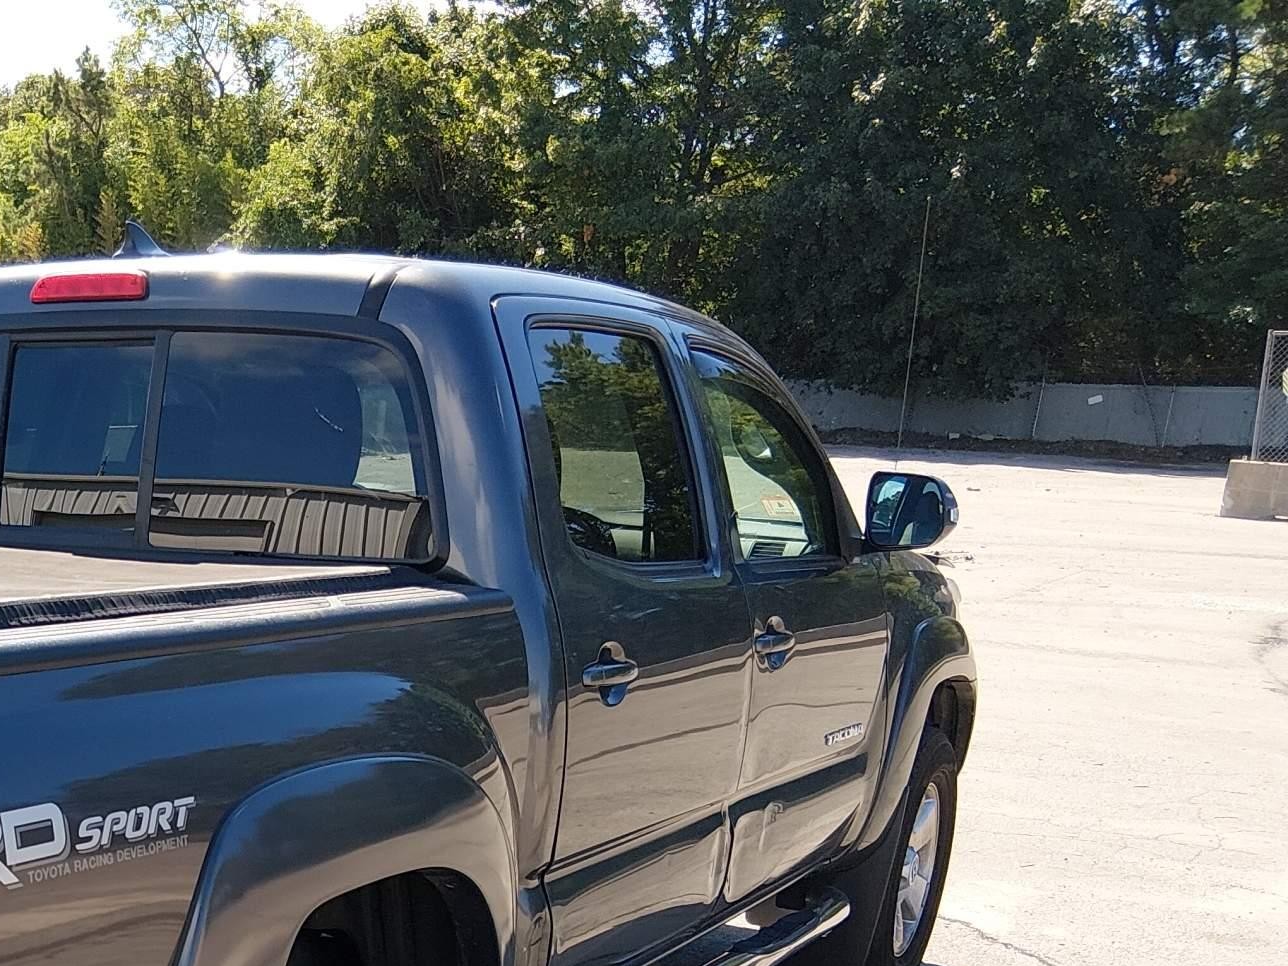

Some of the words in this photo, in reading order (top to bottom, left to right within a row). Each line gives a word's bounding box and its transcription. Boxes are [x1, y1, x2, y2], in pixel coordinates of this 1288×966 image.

[825, 722, 863, 746] TACOMA
[75, 796, 197, 851] SPORT
[27, 863, 71, 883] TOYOTA
[74, 853, 114, 873] RACING
[117, 834, 189, 861] DEVELOPMENT
